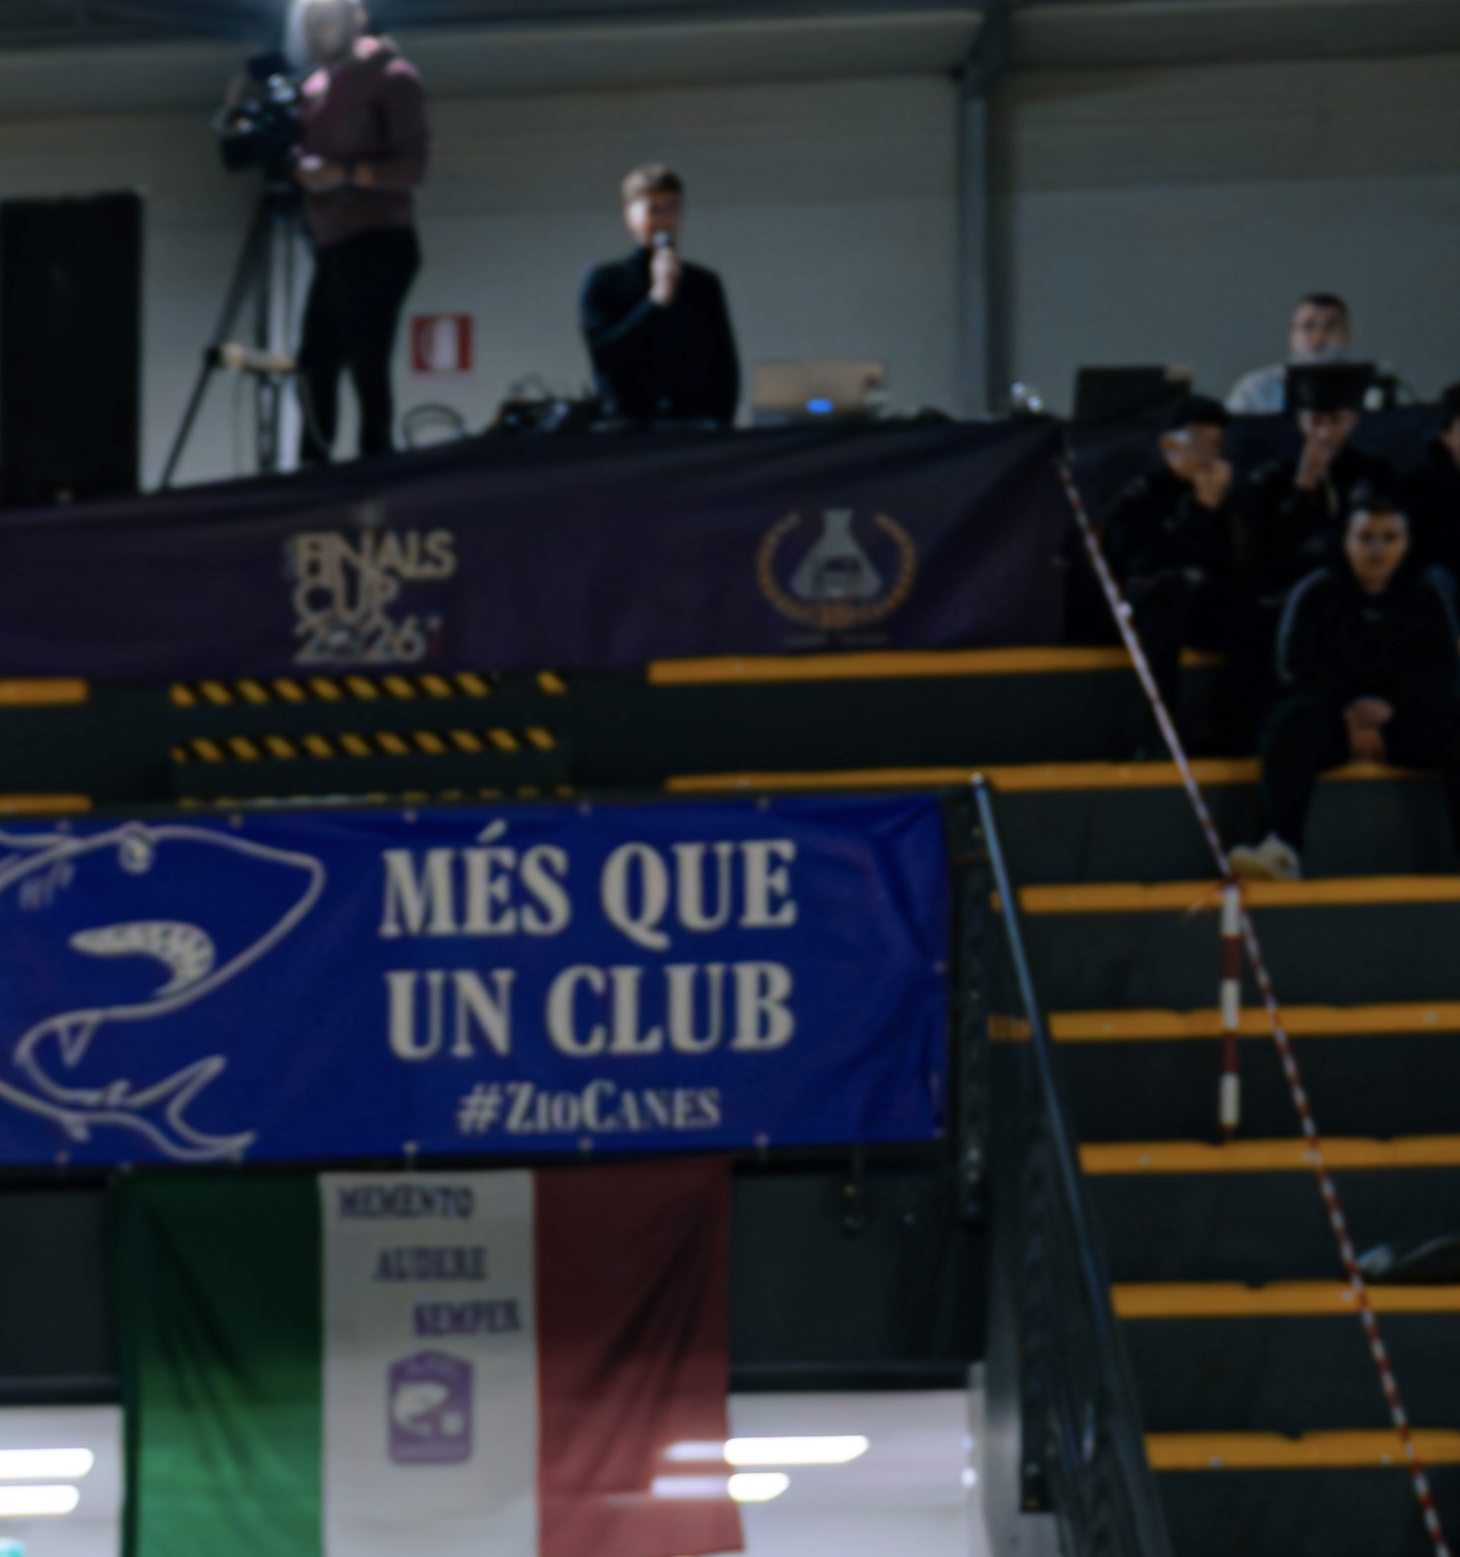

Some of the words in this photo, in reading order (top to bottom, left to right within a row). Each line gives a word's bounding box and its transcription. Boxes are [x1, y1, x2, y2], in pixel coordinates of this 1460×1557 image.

[293, 531, 456, 580] FINALS
[380, 820, 570, 938] MÉS
[601, 840, 798, 951] QUE
[385, 969, 515, 1060] UN
[545, 960, 796, 1057] CLUB
[337, 1186, 474, 1219] MEMENTO
[375, 1247, 487, 1281] AUDERE
[413, 1300, 522, 1337] SEMPER
